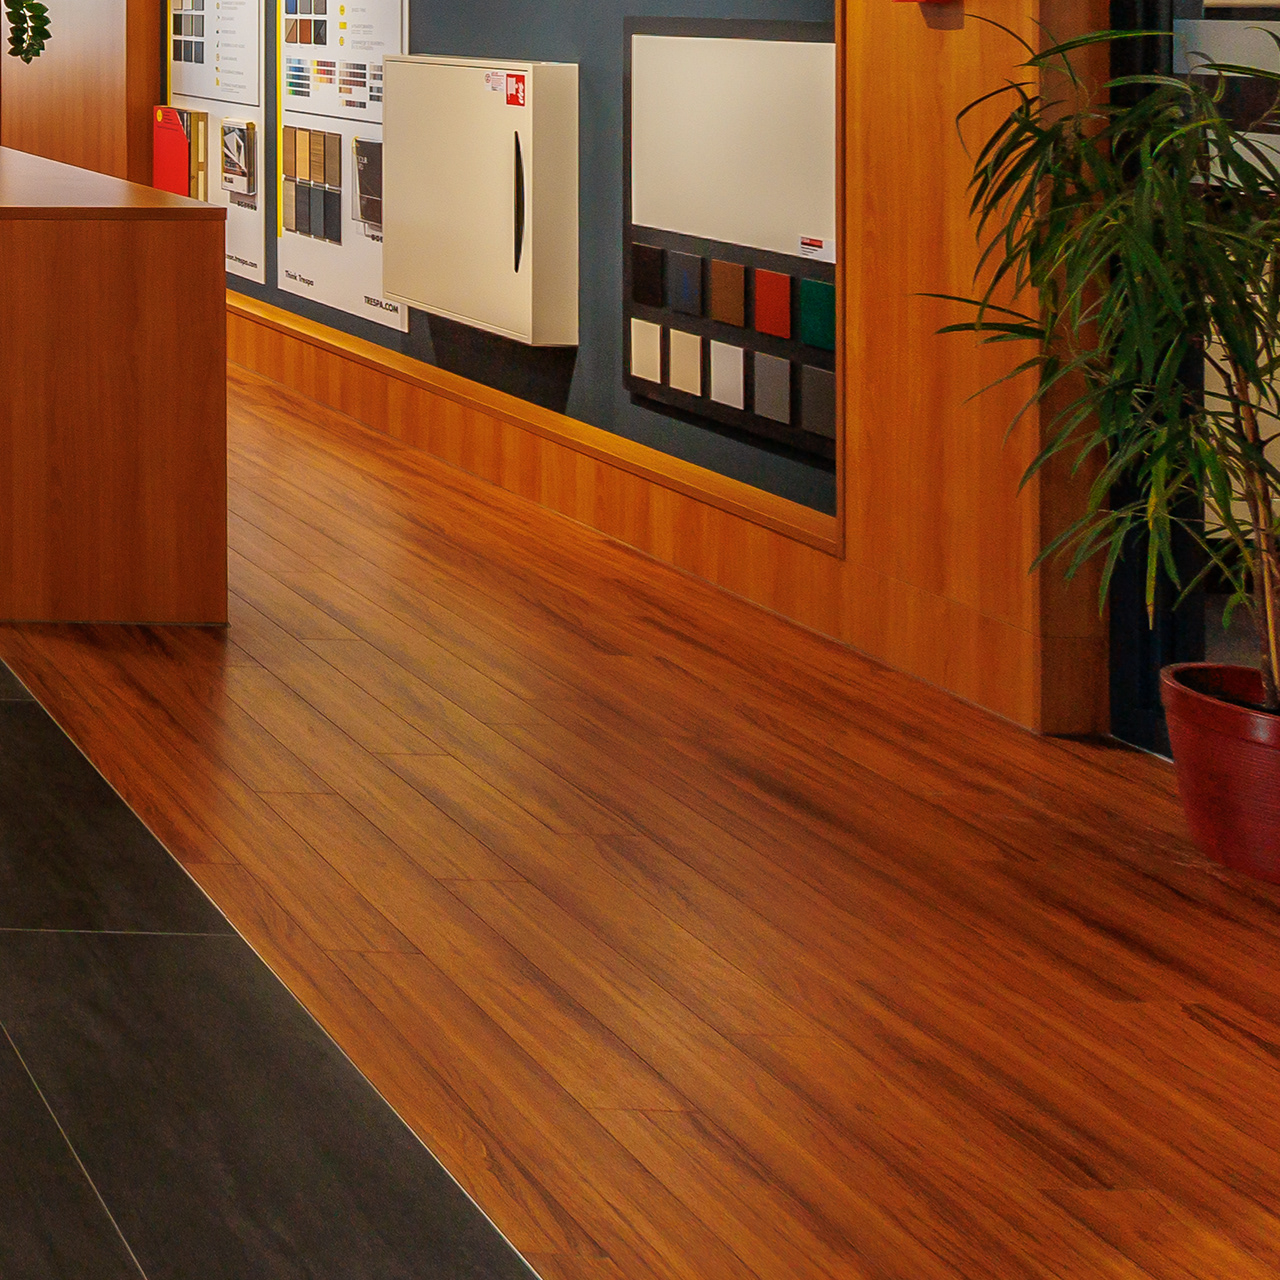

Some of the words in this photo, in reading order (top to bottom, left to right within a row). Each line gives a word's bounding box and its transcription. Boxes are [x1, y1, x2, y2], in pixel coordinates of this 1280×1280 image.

[284, 269, 298, 281] Think
[299, 274, 314, 287] Trespa
[364, 295, 399, 314] TRESPA.COM
